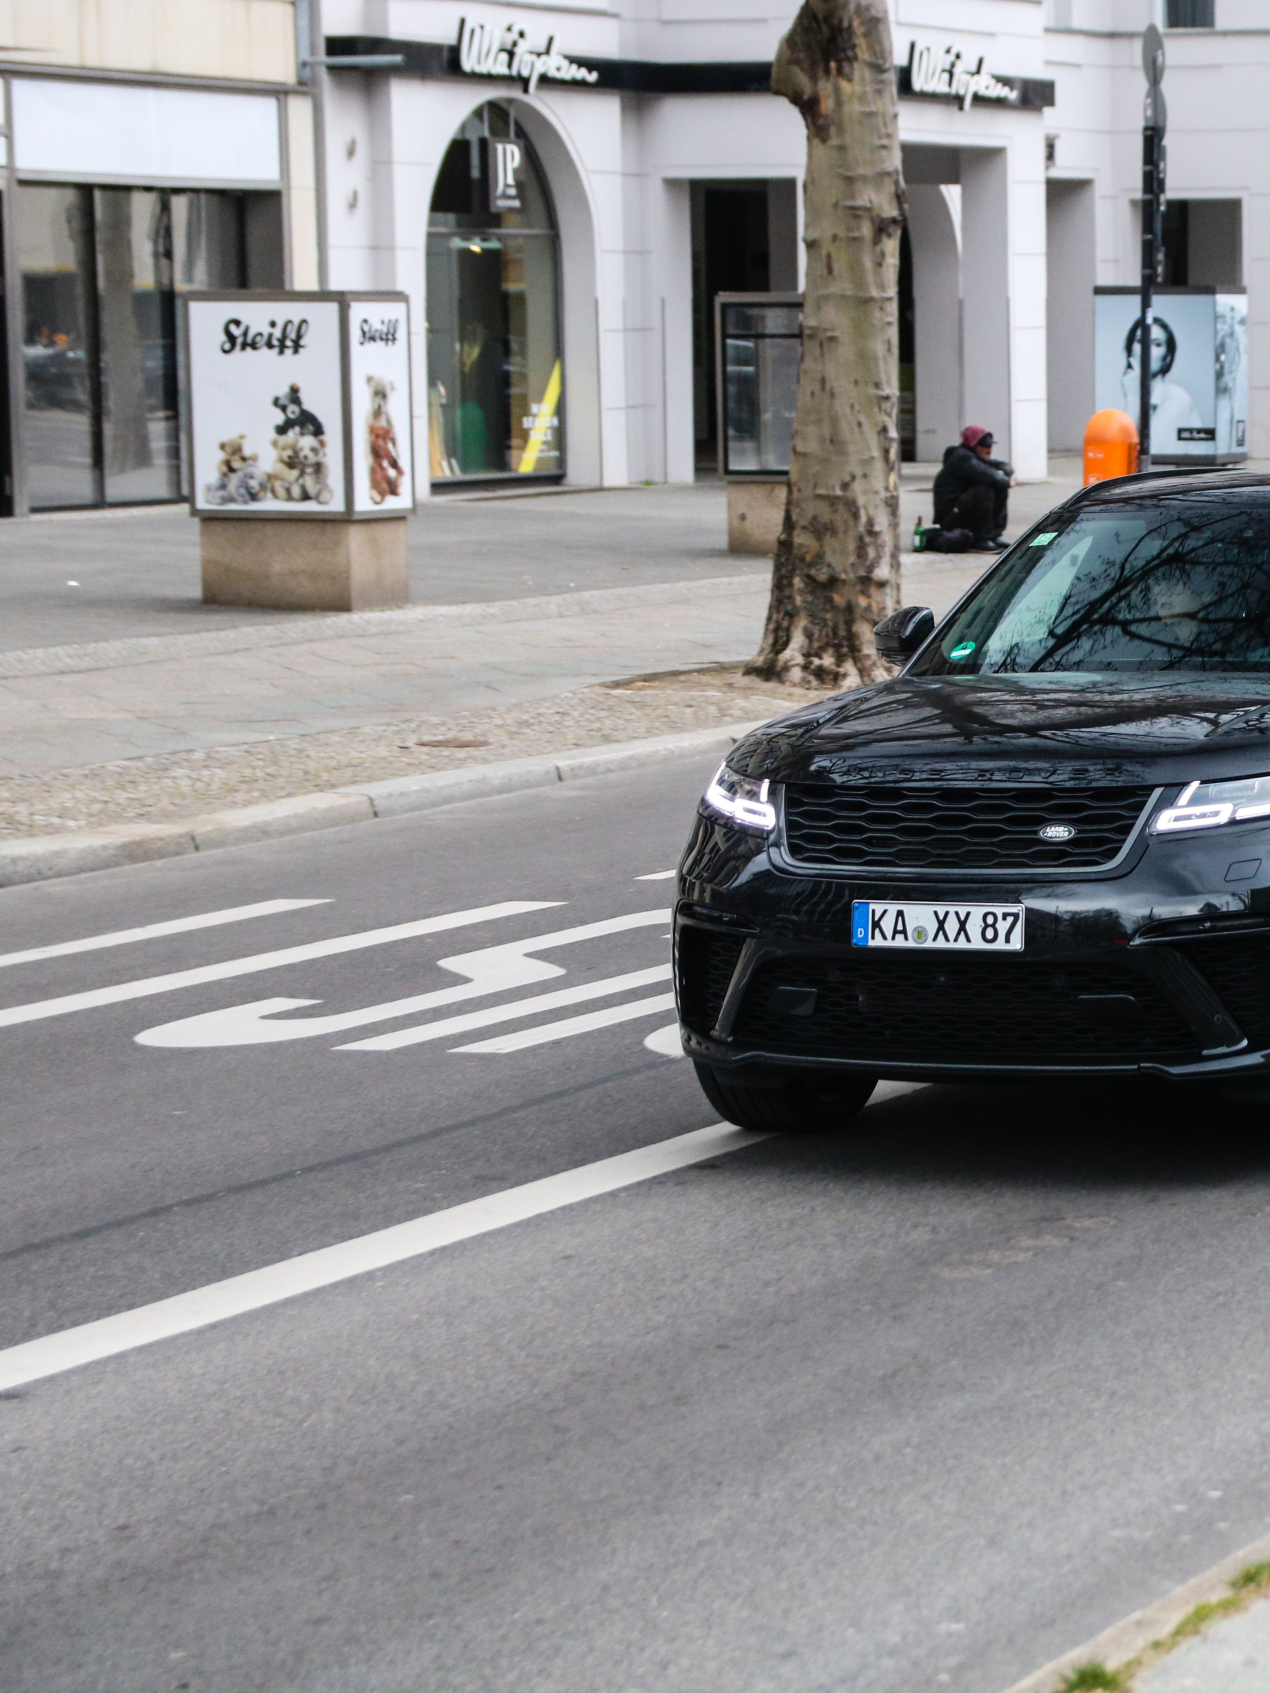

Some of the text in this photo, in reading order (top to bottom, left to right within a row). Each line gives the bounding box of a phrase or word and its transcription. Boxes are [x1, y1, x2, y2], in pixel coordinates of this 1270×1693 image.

[496, 143, 521, 197] JP
[220, 318, 309, 355] Steiff
[358, 318, 400, 346] Steiff
[857, 927, 865, 938] D
[870, 908, 1021, 944] KA XX 87
